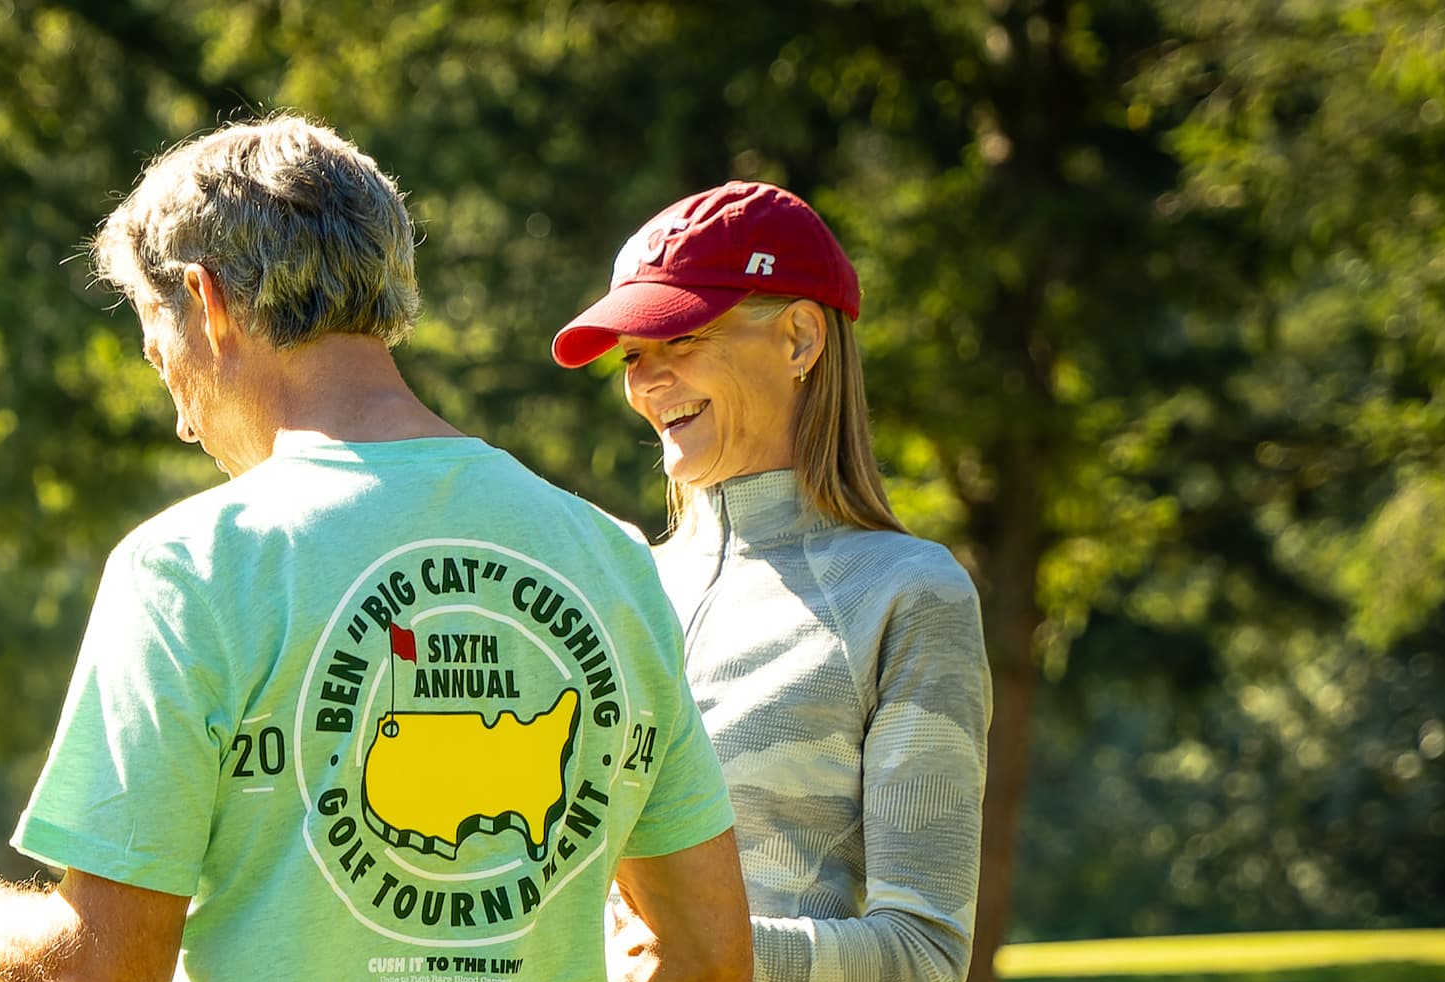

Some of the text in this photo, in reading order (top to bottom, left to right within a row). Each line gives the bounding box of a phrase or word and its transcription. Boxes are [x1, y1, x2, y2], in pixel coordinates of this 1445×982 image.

[745, 252, 776, 276] R
[316, 558, 621, 732] BEN "BIG CAT" CUSHING
[428, 634, 499, 664] SIXTH
[413, 669, 521, 698] ANNUAL
[232, 726, 286, 778] 20
[623, 724, 657, 773] 24
[317, 787, 376, 884] GOLF
[368, 957, 405, 973] CUSH
[409, 957, 423, 973] IT
[426, 957, 449, 972] TO
[453, 957, 486, 973] THE
